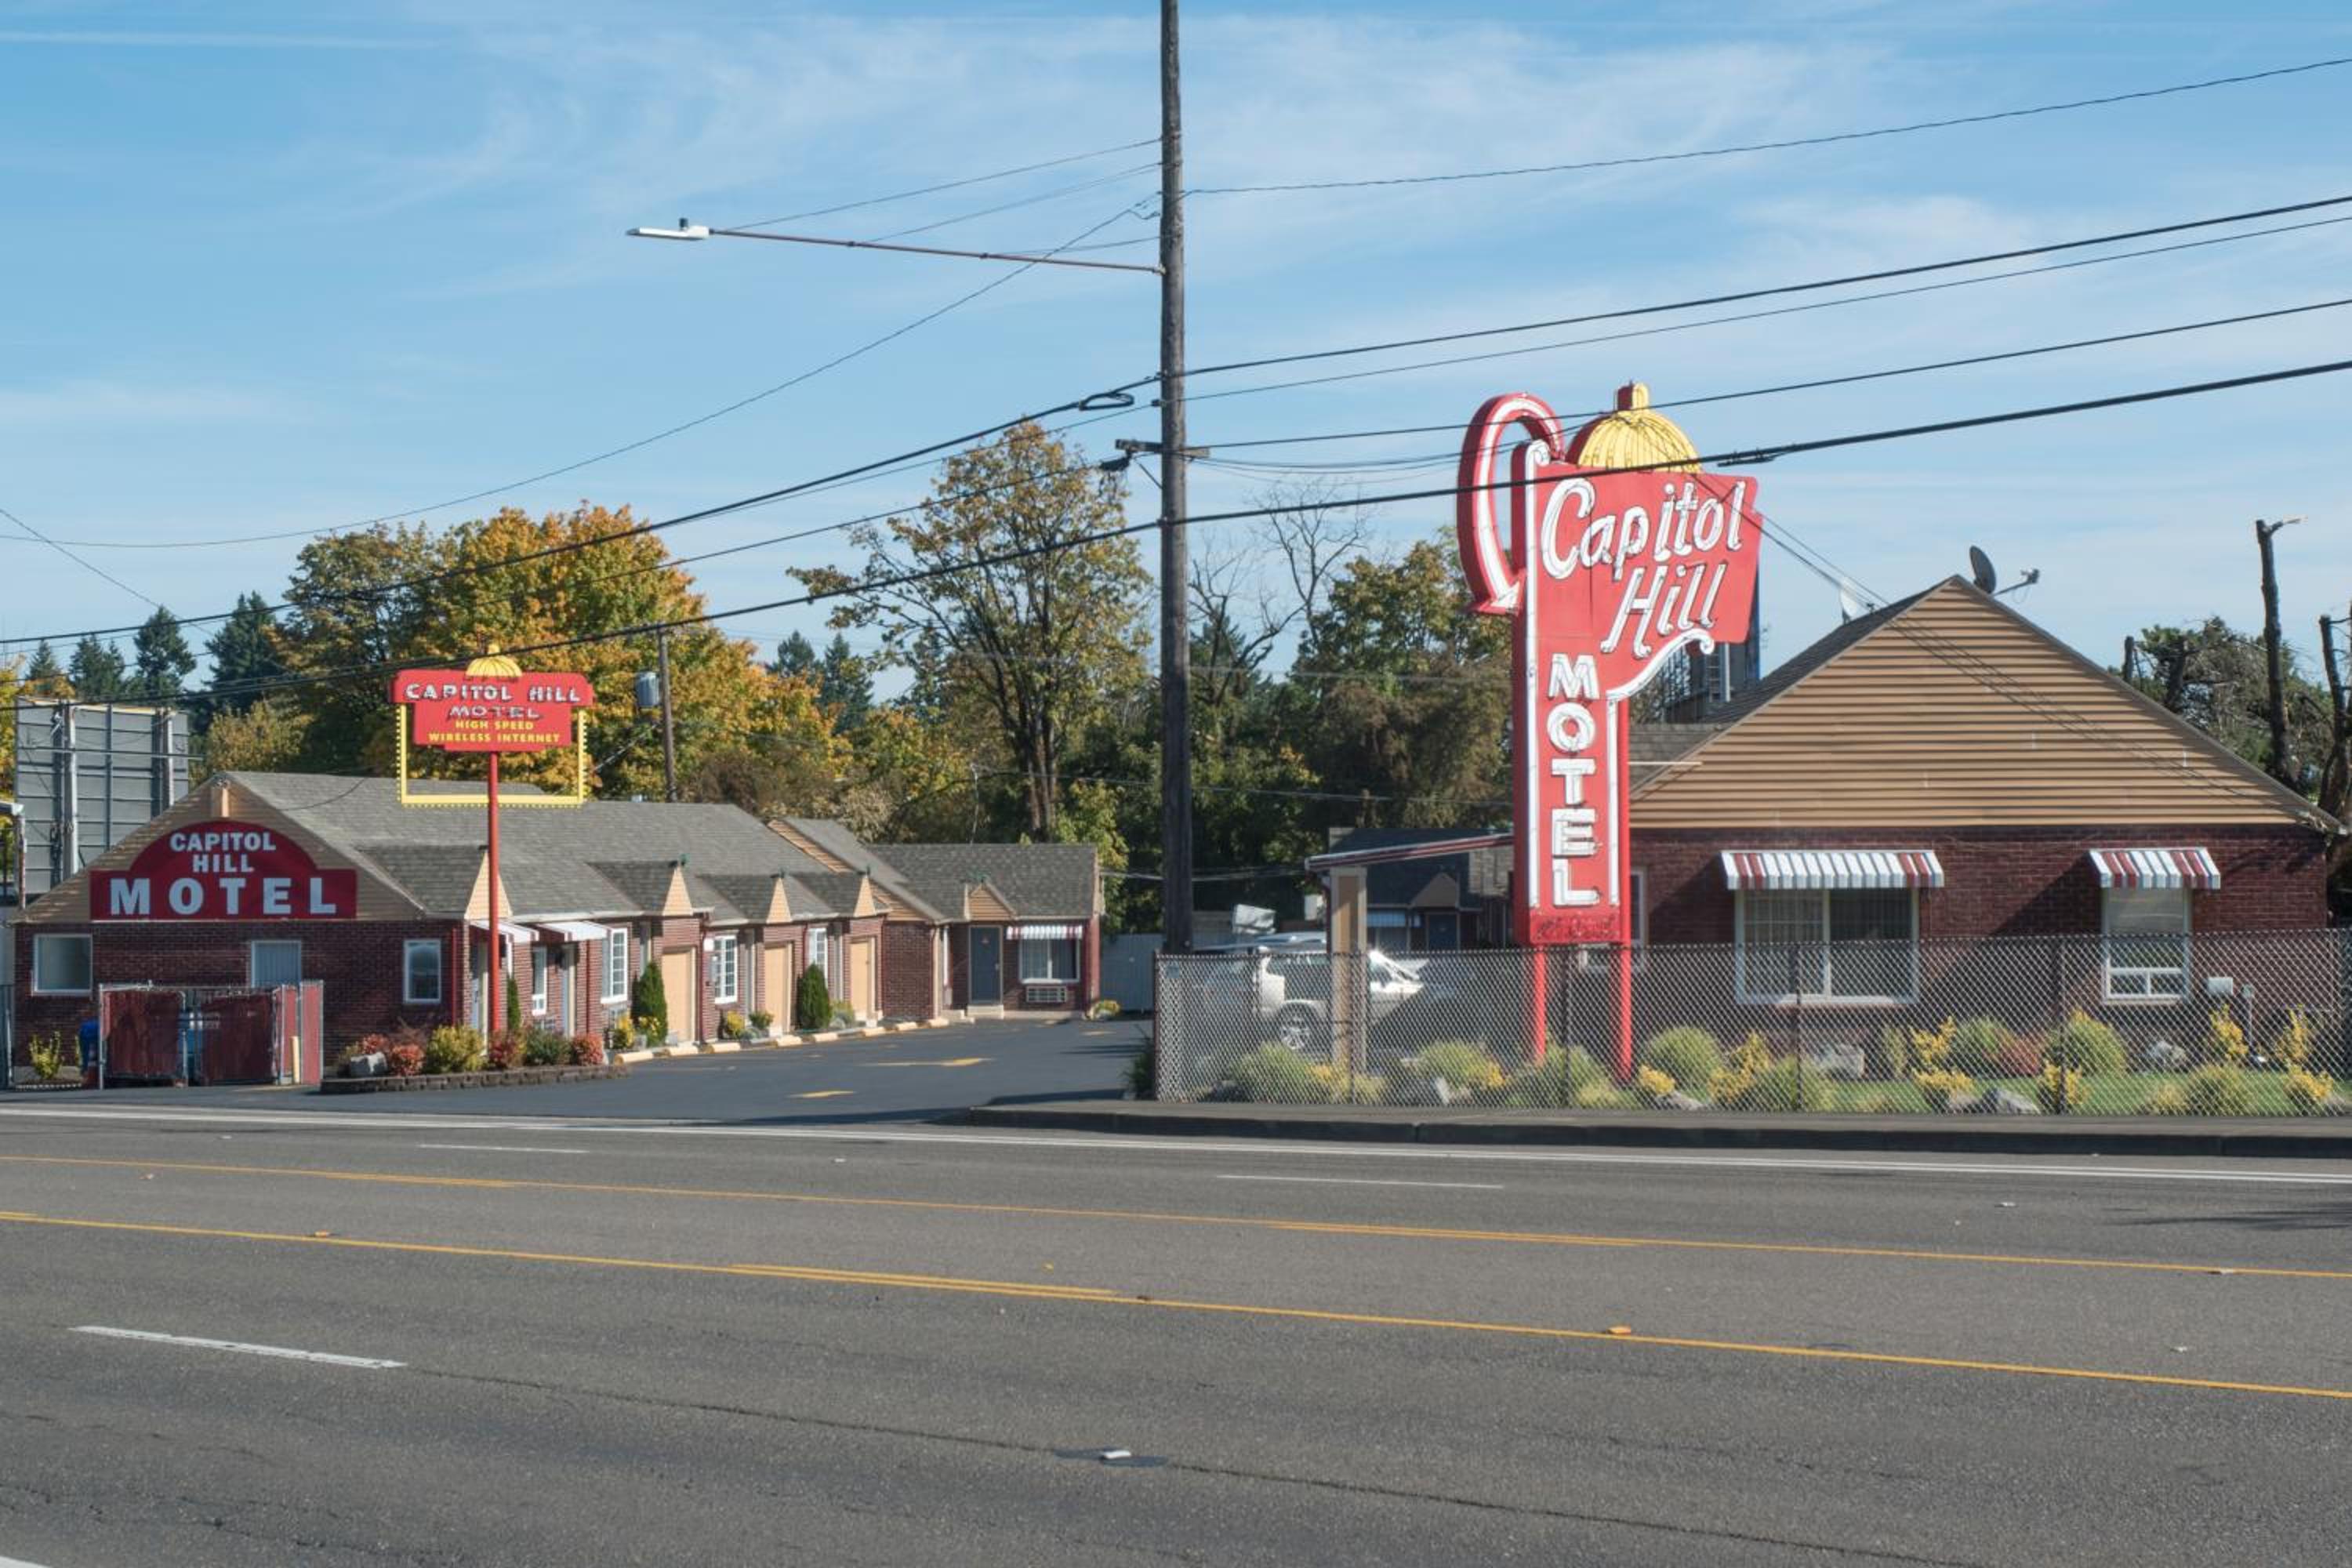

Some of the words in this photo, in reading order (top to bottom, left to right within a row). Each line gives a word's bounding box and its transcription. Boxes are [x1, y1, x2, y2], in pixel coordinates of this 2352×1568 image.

[1541, 478, 1746, 580] Capitol
[1600, 562, 1726, 657] Hill
[405, 683, 513, 700] CAPITOL
[529, 686, 581, 702] HILL
[449, 706, 540, 718] MOTEL
[455, 720, 488, 730] HIGH
[494, 720, 534, 730] SPEED
[429, 732, 492, 742] WIRELESS
[497, 733, 561, 743] INTERNET
[1547, 652, 1602, 906] MOTEL
[170, 833, 276, 851] CAPITOL
[193, 855, 254, 873] HILL
[110, 878, 337, 916] MOTEL
